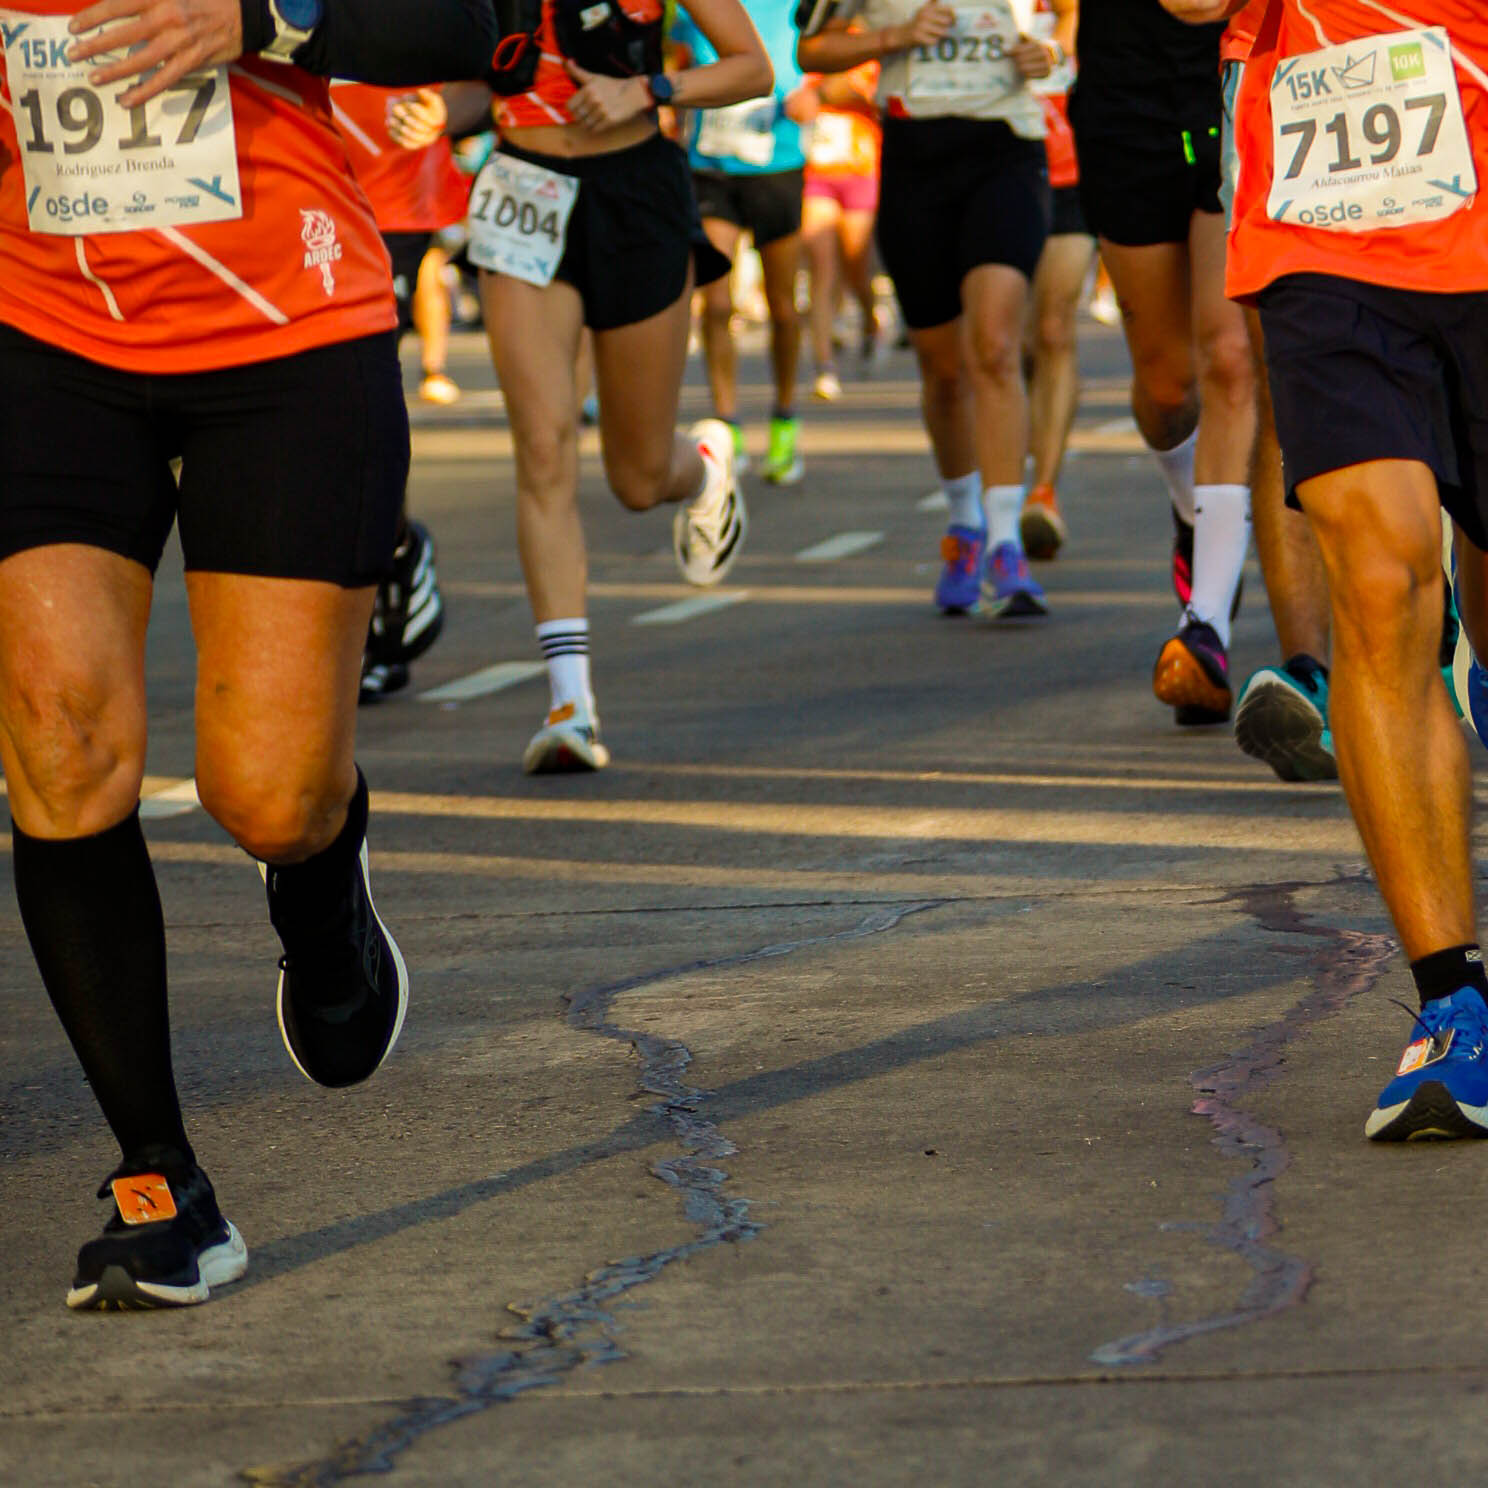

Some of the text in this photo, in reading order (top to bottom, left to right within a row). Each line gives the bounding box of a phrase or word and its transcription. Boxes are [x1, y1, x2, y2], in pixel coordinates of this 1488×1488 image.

[20, 38, 72, 69] 15K
[1393, 52, 1421, 68] 10K
[1286, 68, 1332, 102] 15K
[20, 76, 217, 154] 1917
[1280, 93, 1447, 180] 7197
[126, 156, 175, 173] Brenda
[46, 193, 109, 222] osde
[472, 189, 559, 244] 1004
[1299, 200, 1363, 226] osde
